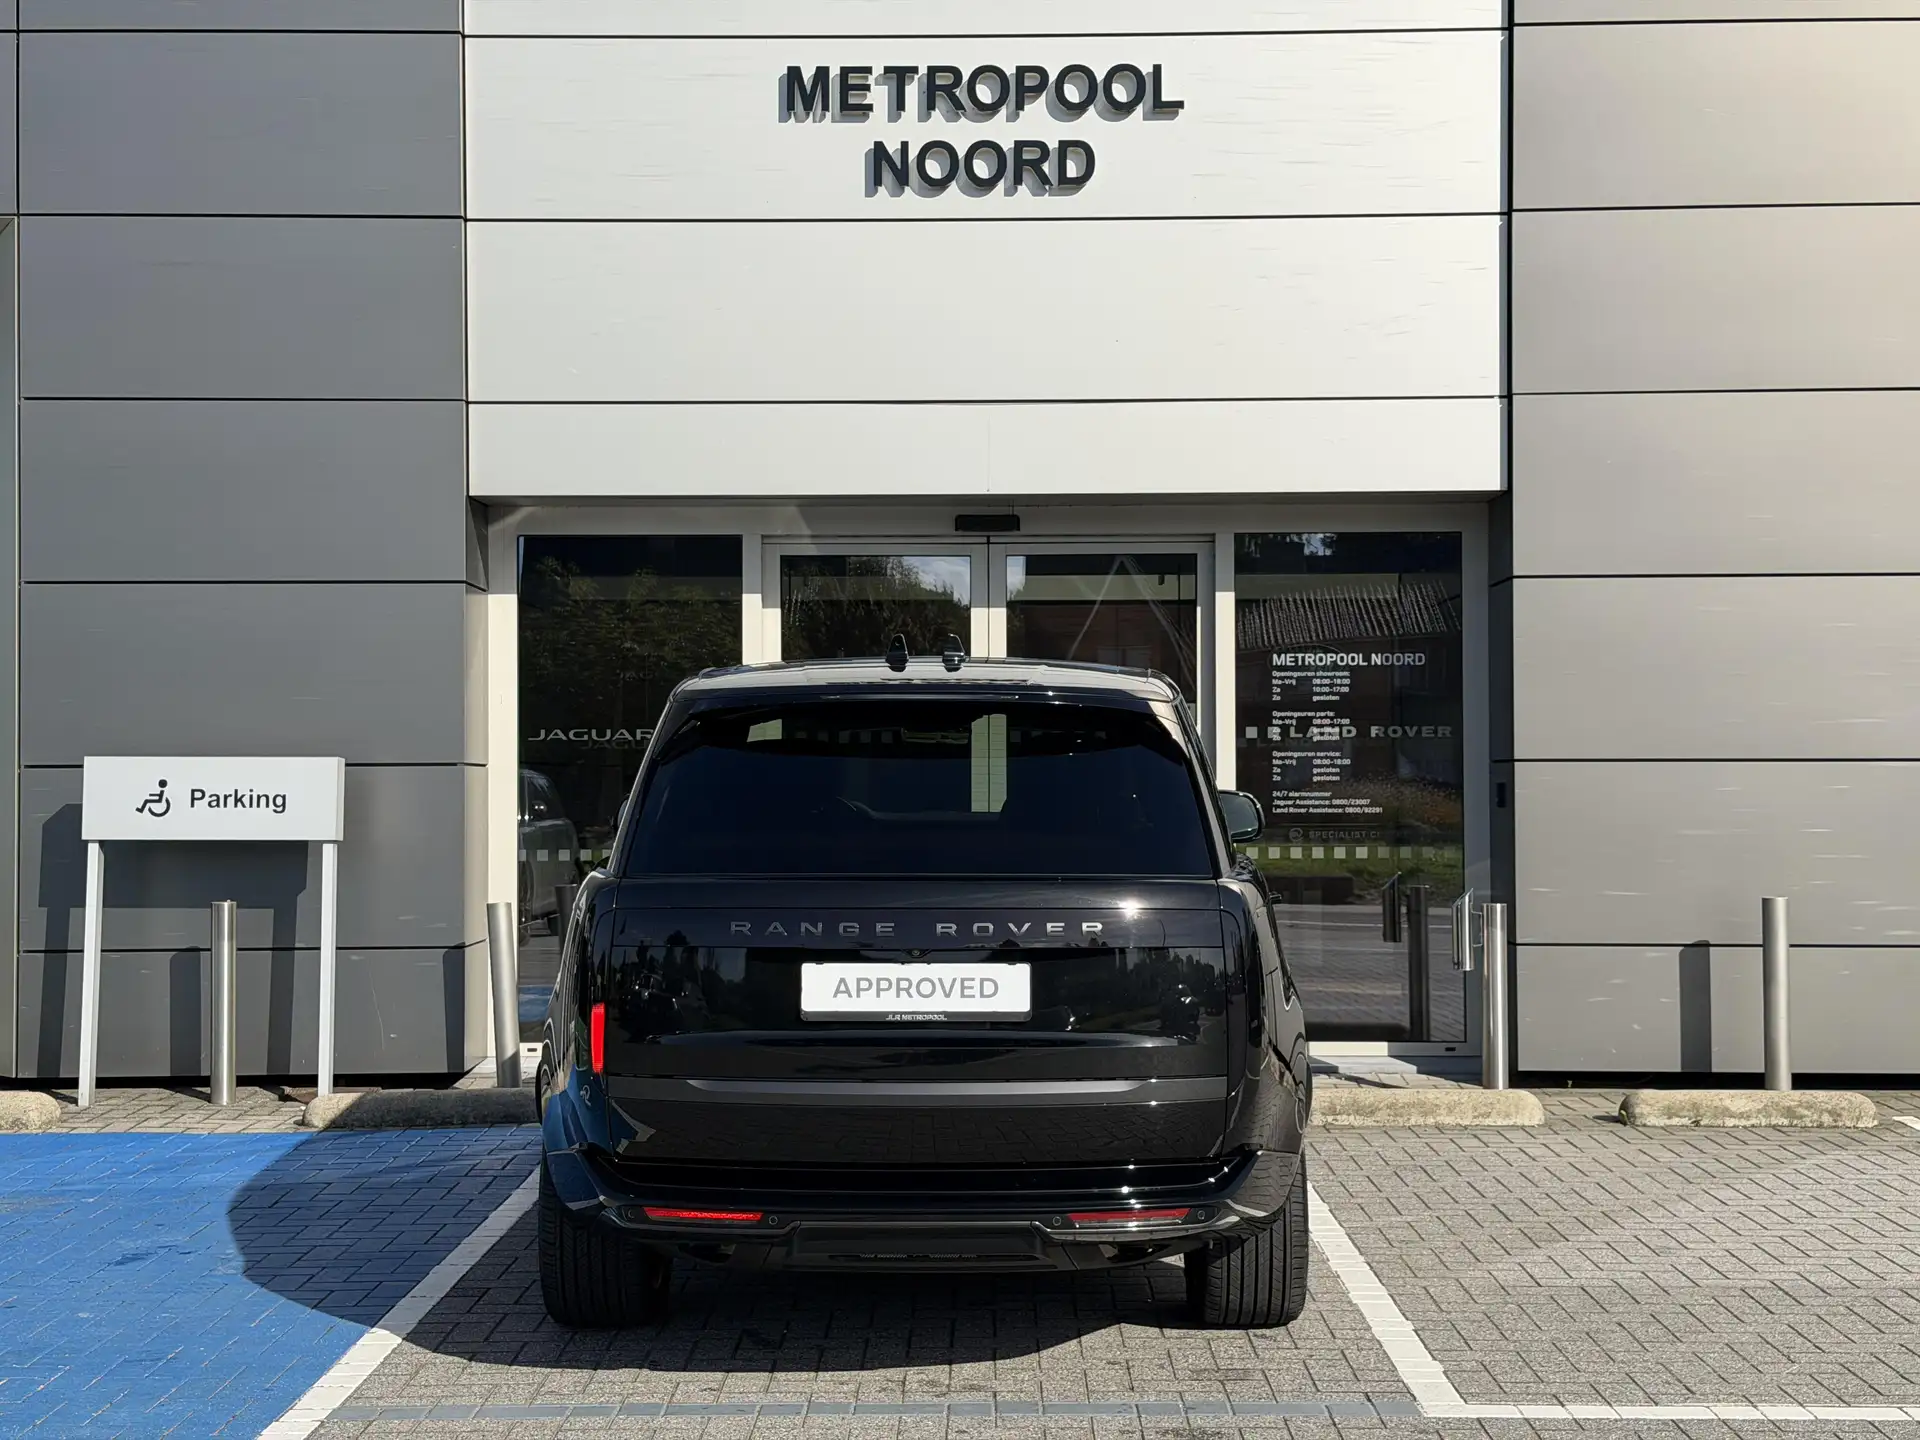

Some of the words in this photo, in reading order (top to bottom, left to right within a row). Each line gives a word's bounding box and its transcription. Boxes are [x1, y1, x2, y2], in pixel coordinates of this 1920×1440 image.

[786, 63, 1185, 113] METROPOOL
[873, 139, 1096, 188] NOORD
[1272, 653, 1368, 666] METROPOOL
[1371, 653, 1426, 666] NOORD
[528, 729, 654, 741] JAGUAR
[1370, 726, 1453, 738] ROVER
[189, 788, 288, 815] Parking
[729, 921, 896, 937] RANGE
[936, 921, 1104, 937] ROVER
[832, 976, 1000, 999] APPROVED
